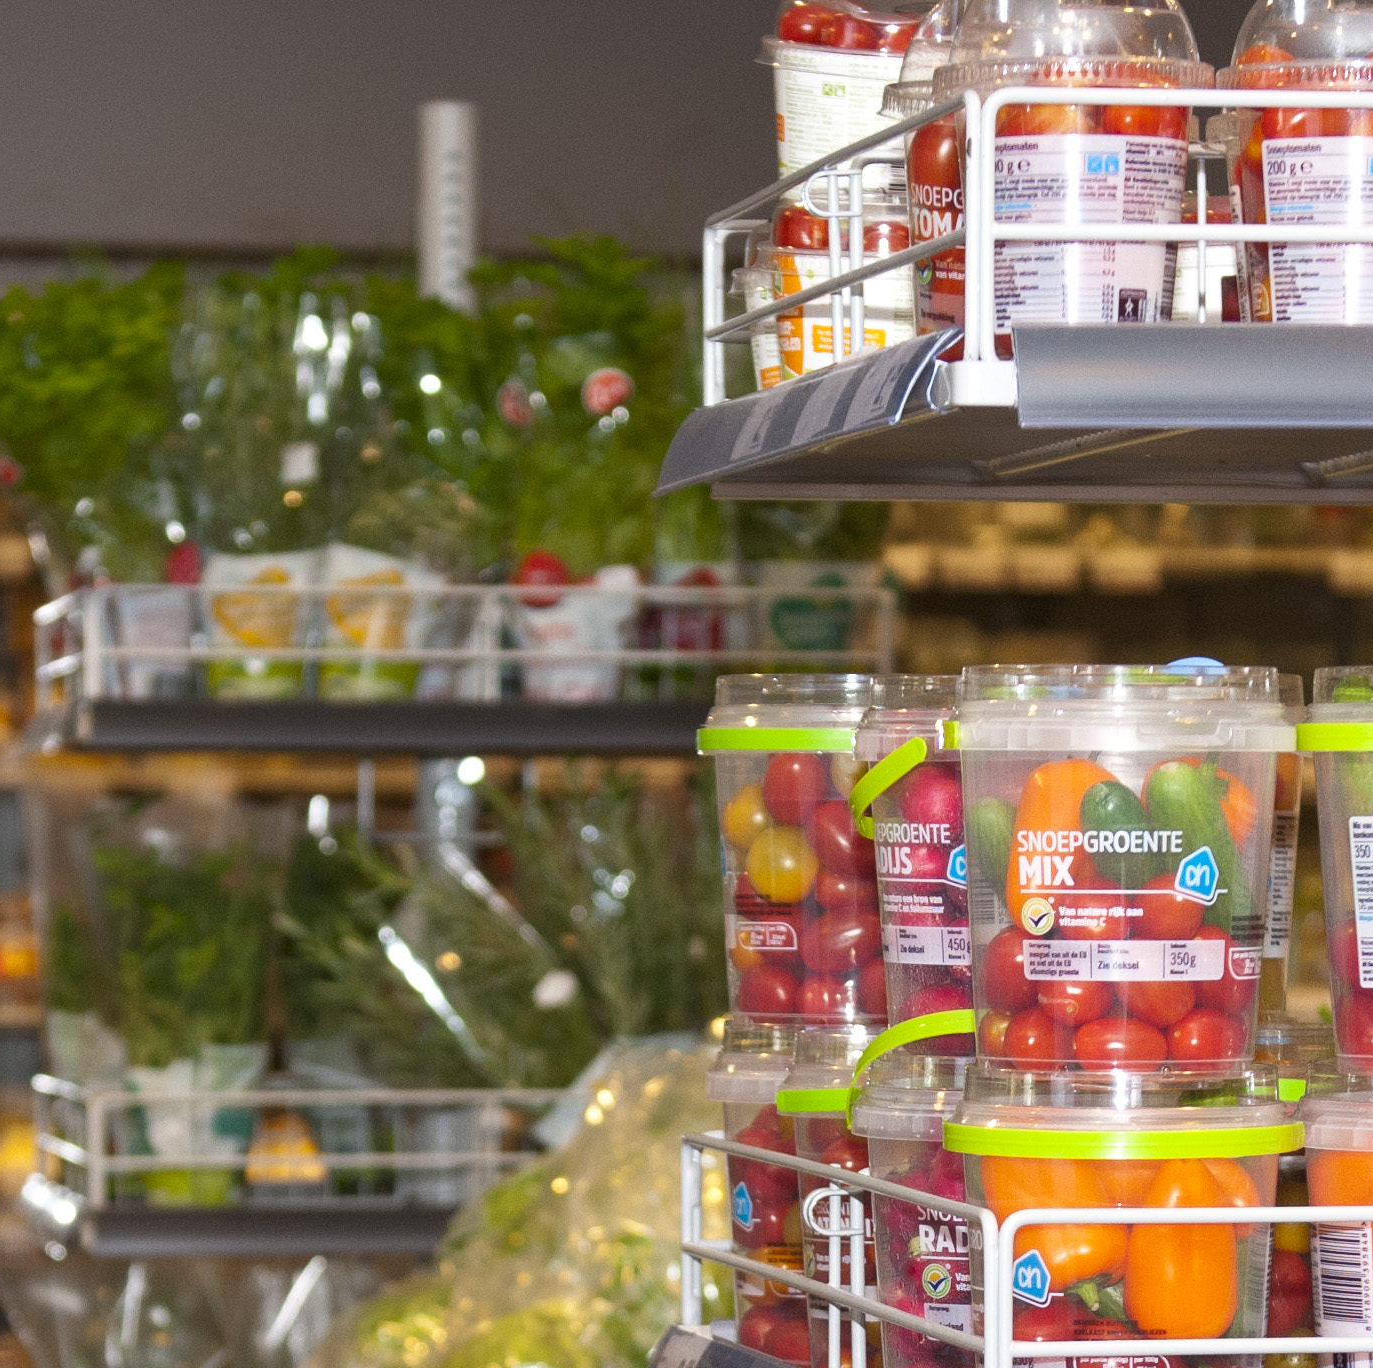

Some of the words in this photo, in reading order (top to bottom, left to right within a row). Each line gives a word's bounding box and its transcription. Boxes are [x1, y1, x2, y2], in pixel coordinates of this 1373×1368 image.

[1267, 160, 1286, 176] 200
[1017, 829, 1183, 853] SNOEPGROENTE
[1018, 855, 1074, 886] MIX
